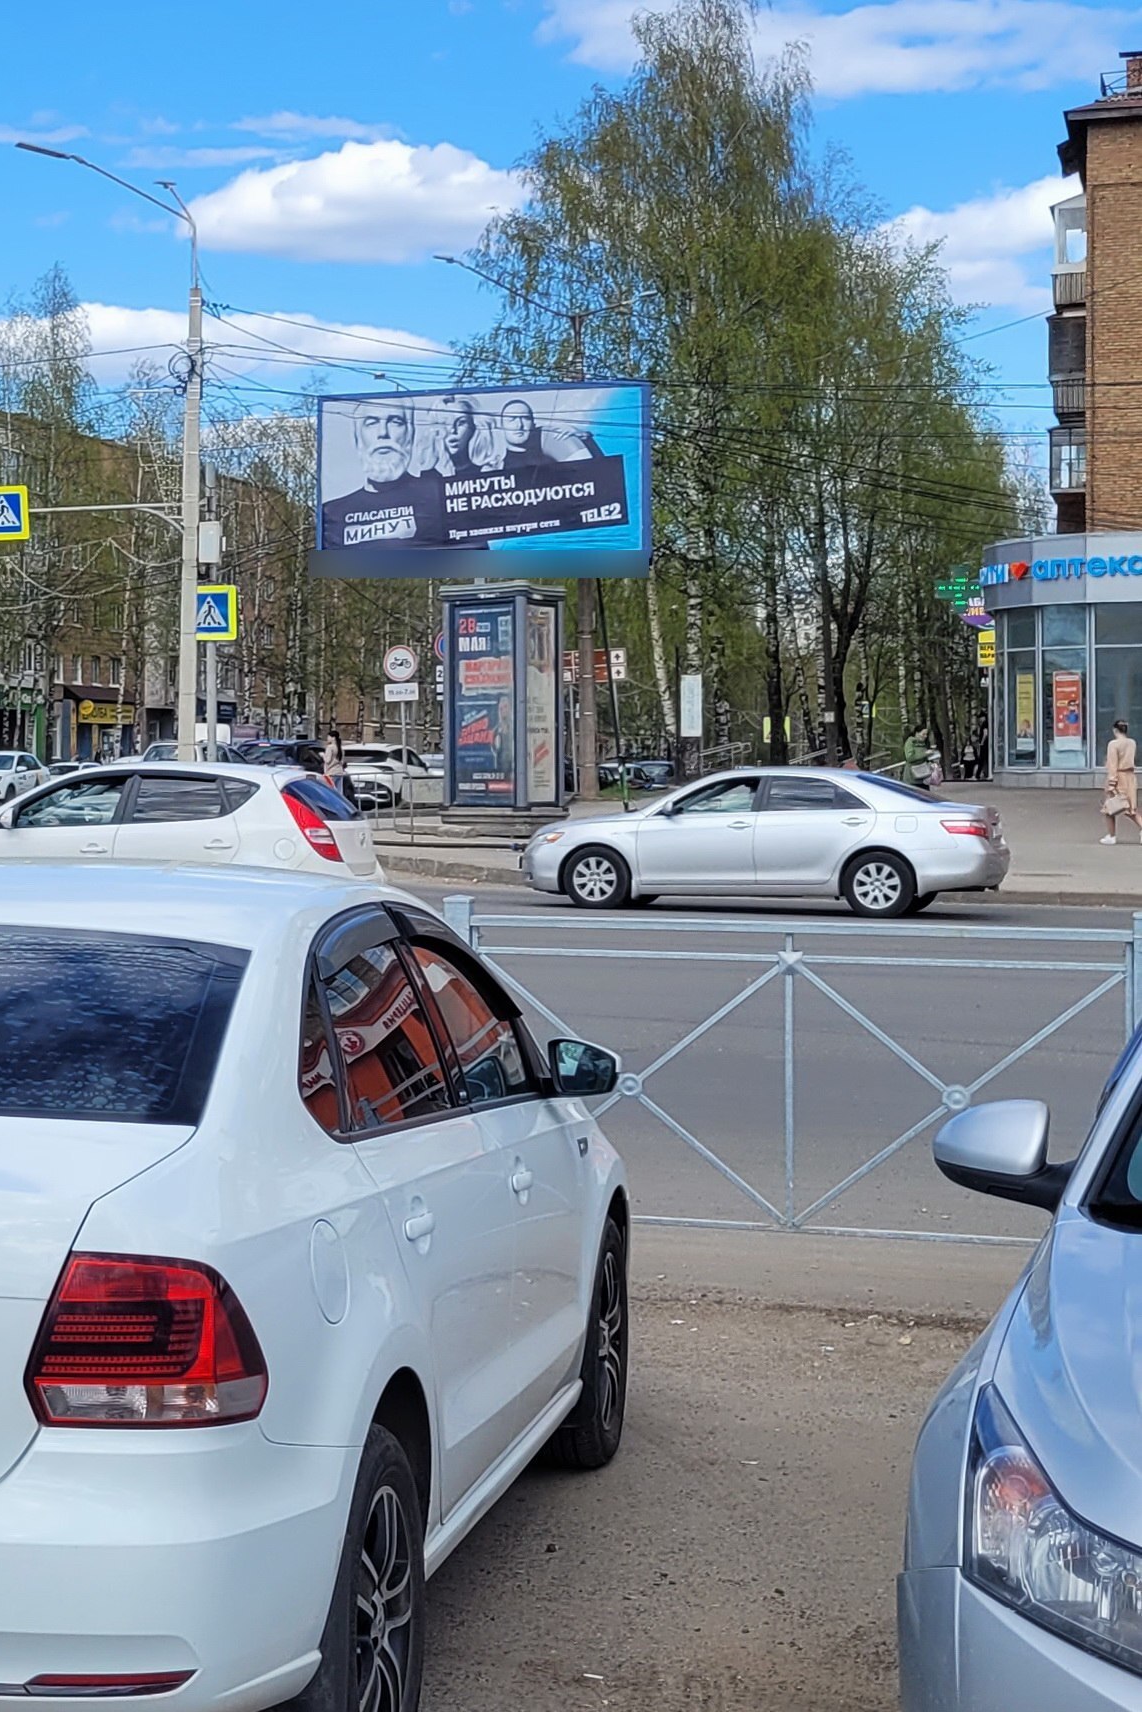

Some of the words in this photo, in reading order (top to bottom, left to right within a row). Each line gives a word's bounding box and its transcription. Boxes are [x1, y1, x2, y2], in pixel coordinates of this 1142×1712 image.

[445, 474, 516, 496] МИНУТЫ
[446, 498, 469, 513] НЕ
[471, 482, 595, 510] РАСХОДУЮТСЯ
[345, 505, 414, 523] СПАСАТЕЛИ
[580, 502, 622, 523] TELE2
[345, 517, 414, 543] МИНУТ
[449, 529, 468, 540] При
[539, 519, 560, 529] сети
[458, 618, 476, 634] 28
[458, 636, 486, 652] МАЯ
